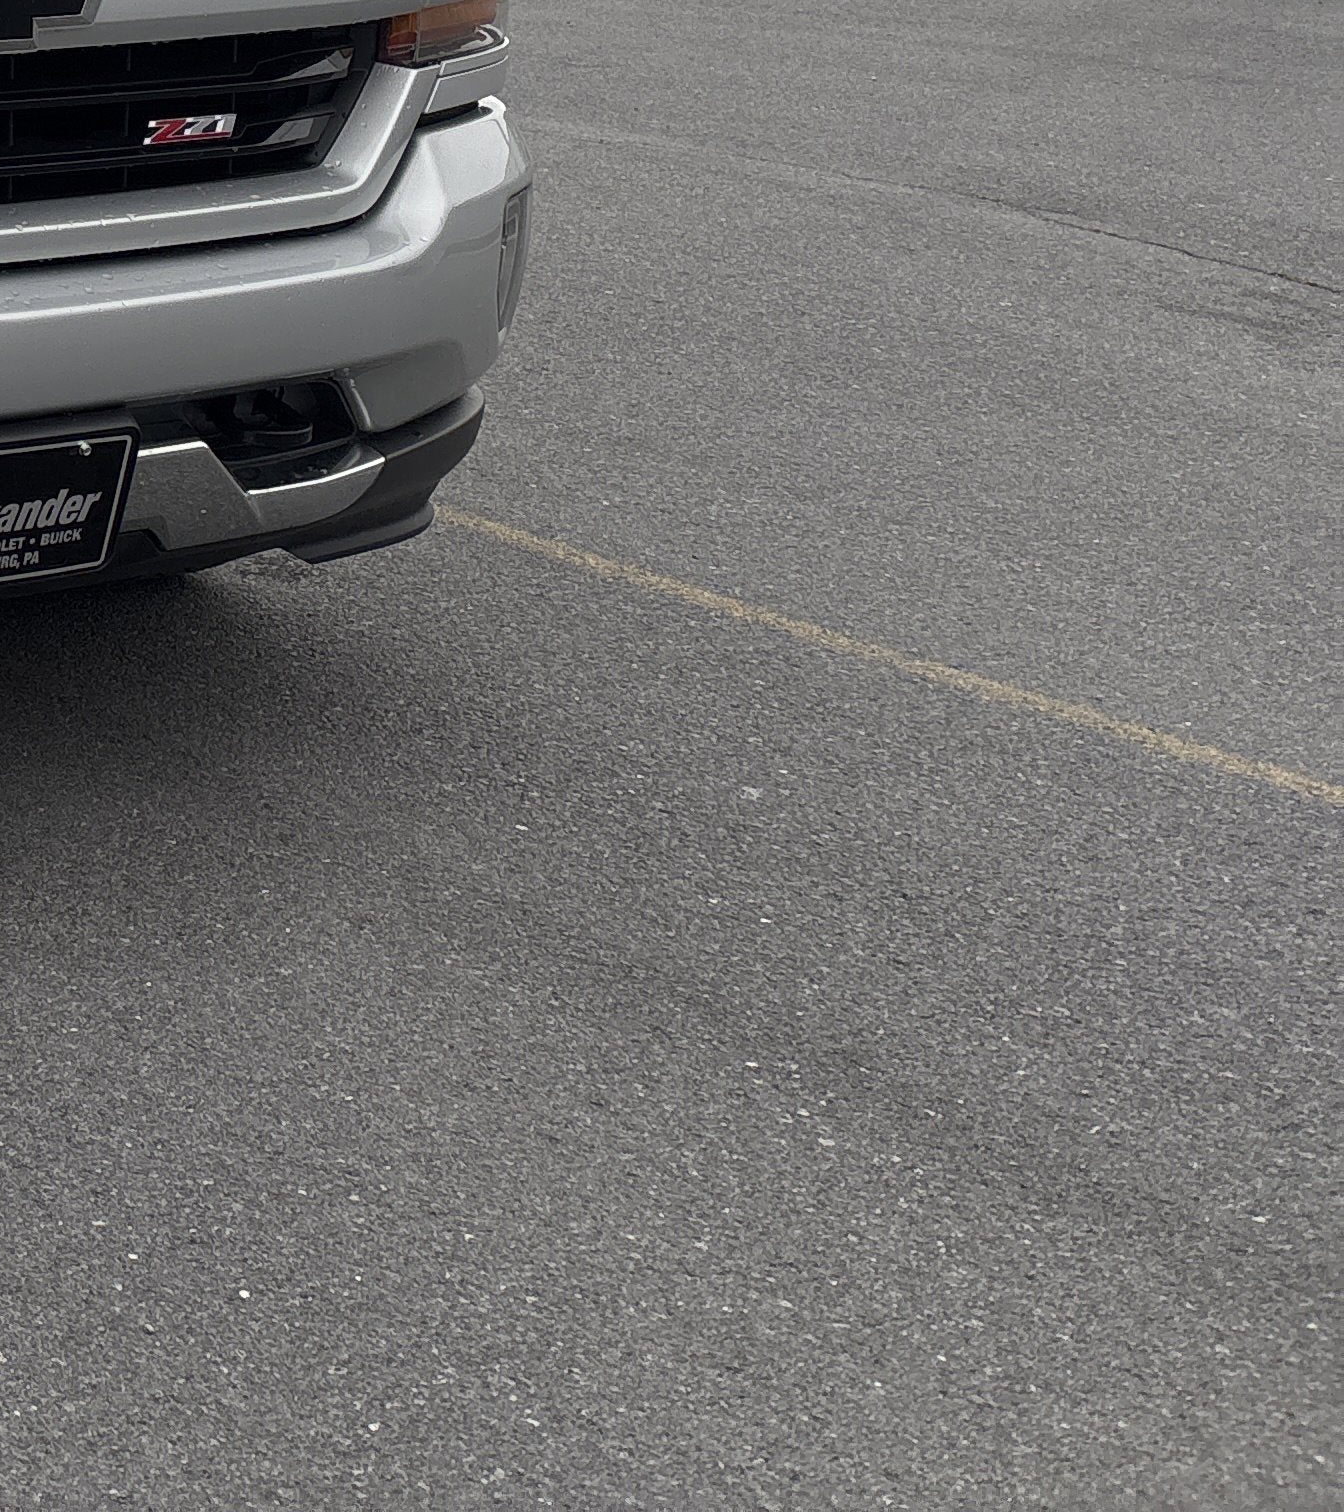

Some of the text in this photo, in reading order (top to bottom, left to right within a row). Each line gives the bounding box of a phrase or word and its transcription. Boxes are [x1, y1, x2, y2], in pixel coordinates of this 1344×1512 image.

[143, 114, 237, 145] Z71
[39, 528, 83, 547] BUICK
[22, 551, 40, 566] PA
